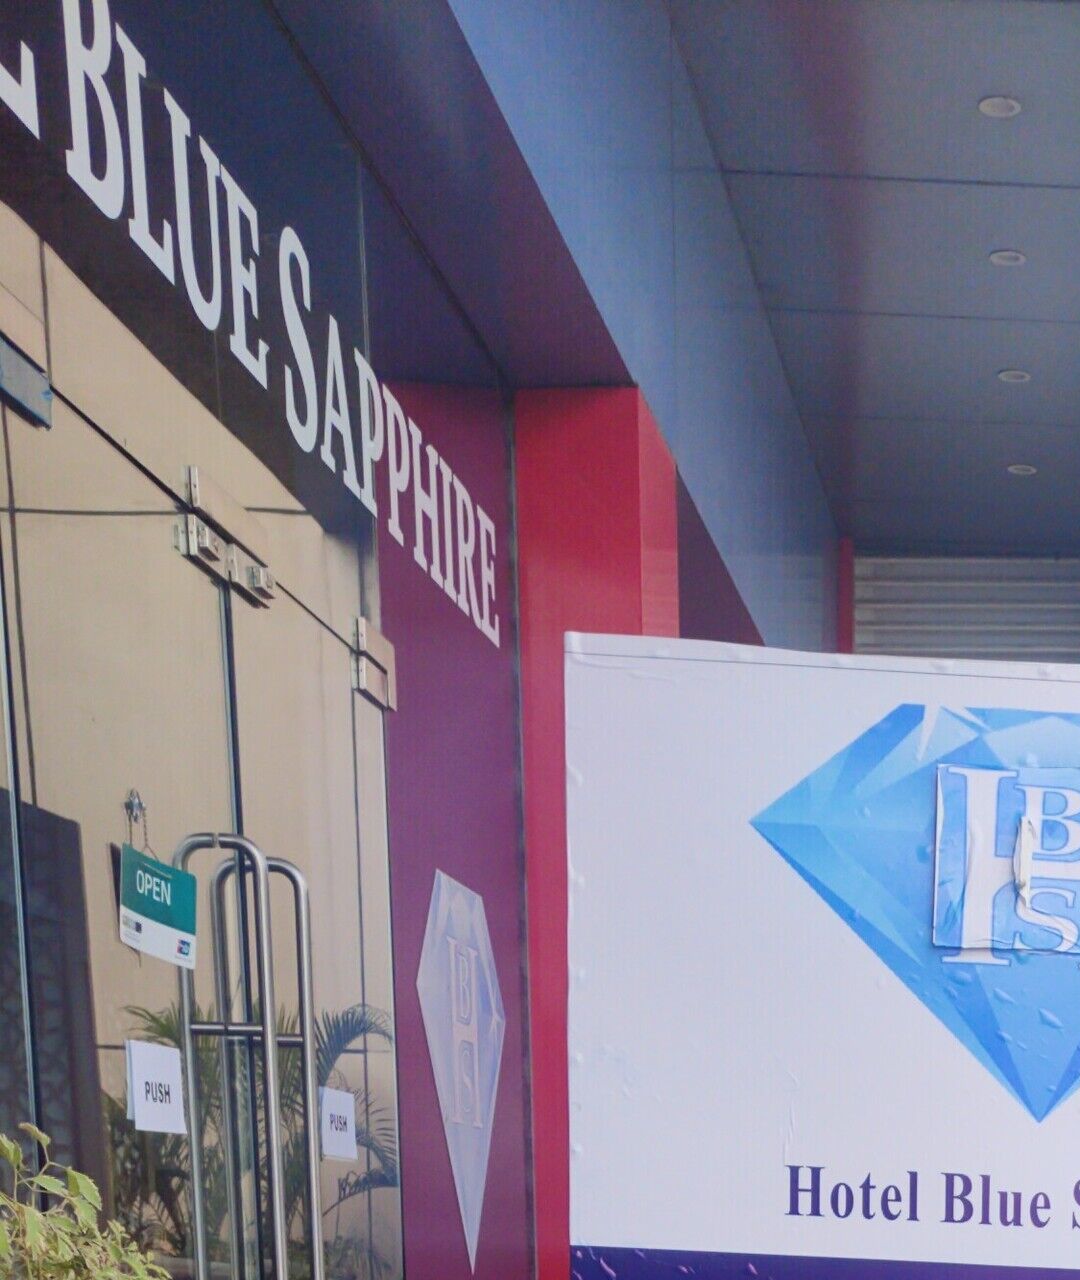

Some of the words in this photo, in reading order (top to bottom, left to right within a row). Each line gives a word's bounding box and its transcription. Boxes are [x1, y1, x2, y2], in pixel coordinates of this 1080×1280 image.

[62, 0, 269, 390] BLUE
[279, 226, 500, 648] SAPPHIRE
[136, 869, 171, 906] OPEN
[144, 1080, 171, 1105] PUSH
[329, 1113, 348, 1132] PUSH
[784, 1164, 920, 1222] Hotel
[940, 1172, 1051, 1229] Blue
